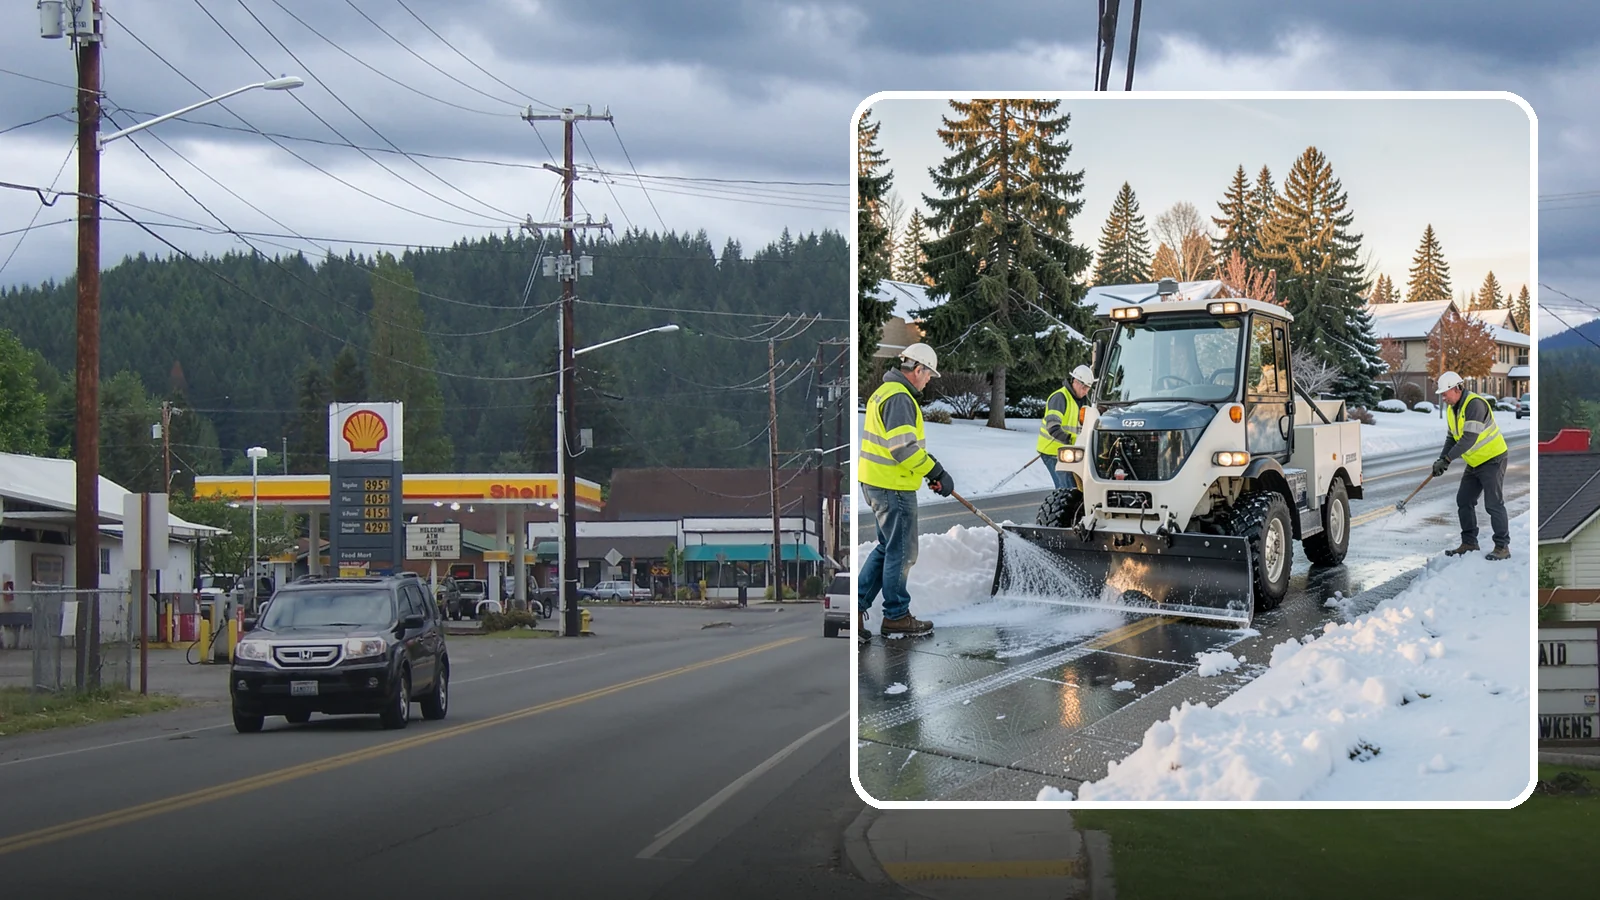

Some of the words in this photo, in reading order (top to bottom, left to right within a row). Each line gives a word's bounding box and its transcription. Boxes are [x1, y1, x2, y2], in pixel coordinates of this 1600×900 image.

[365, 480, 384, 490] 395
[490, 484, 548, 499] Shell
[365, 494, 384, 504] 405
[365, 508, 384, 518] 415
[365, 522, 384, 533] 429
[1538, 643, 1567, 665] AID
[1538, 716, 1592, 738] WKENS
